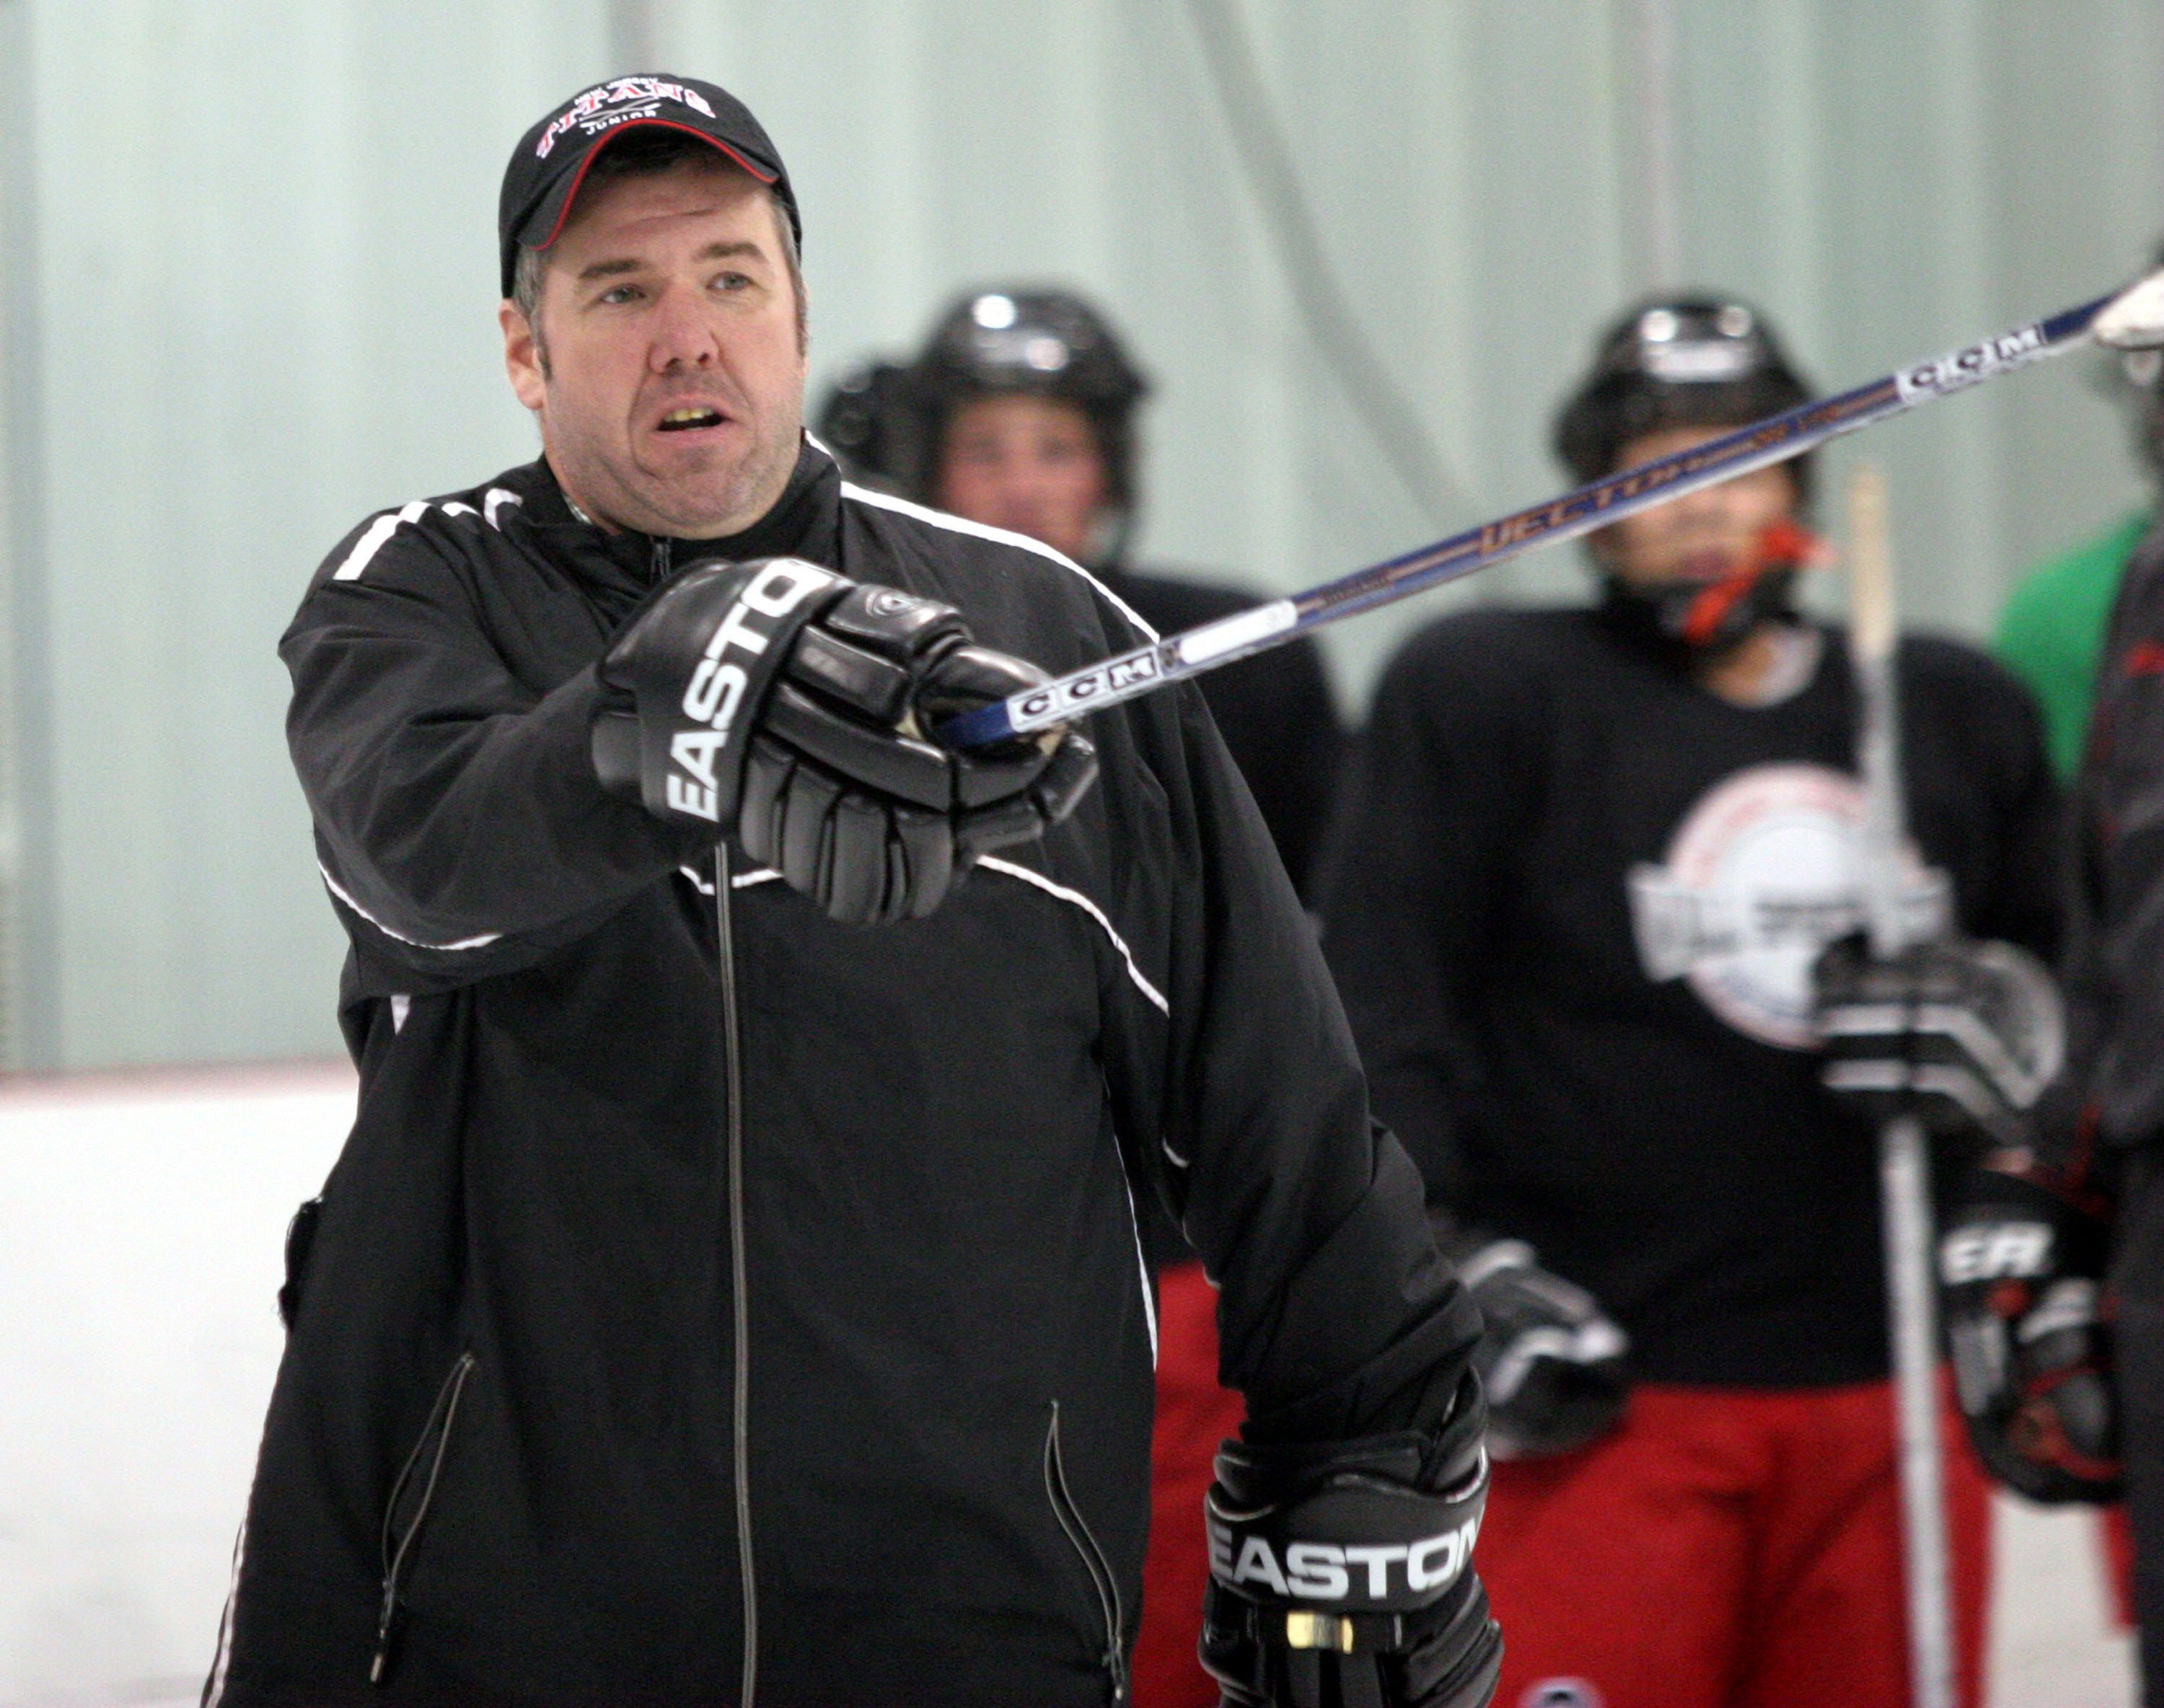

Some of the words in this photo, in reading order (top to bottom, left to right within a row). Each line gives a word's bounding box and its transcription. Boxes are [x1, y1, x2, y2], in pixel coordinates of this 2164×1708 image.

[536, 81, 716, 159] TITANS
[586, 109, 657, 135] JUNIOR
[1909, 325, 2046, 387] CCM
[667, 558, 835, 822] EASTO
[1021, 649, 1161, 716] CCM
